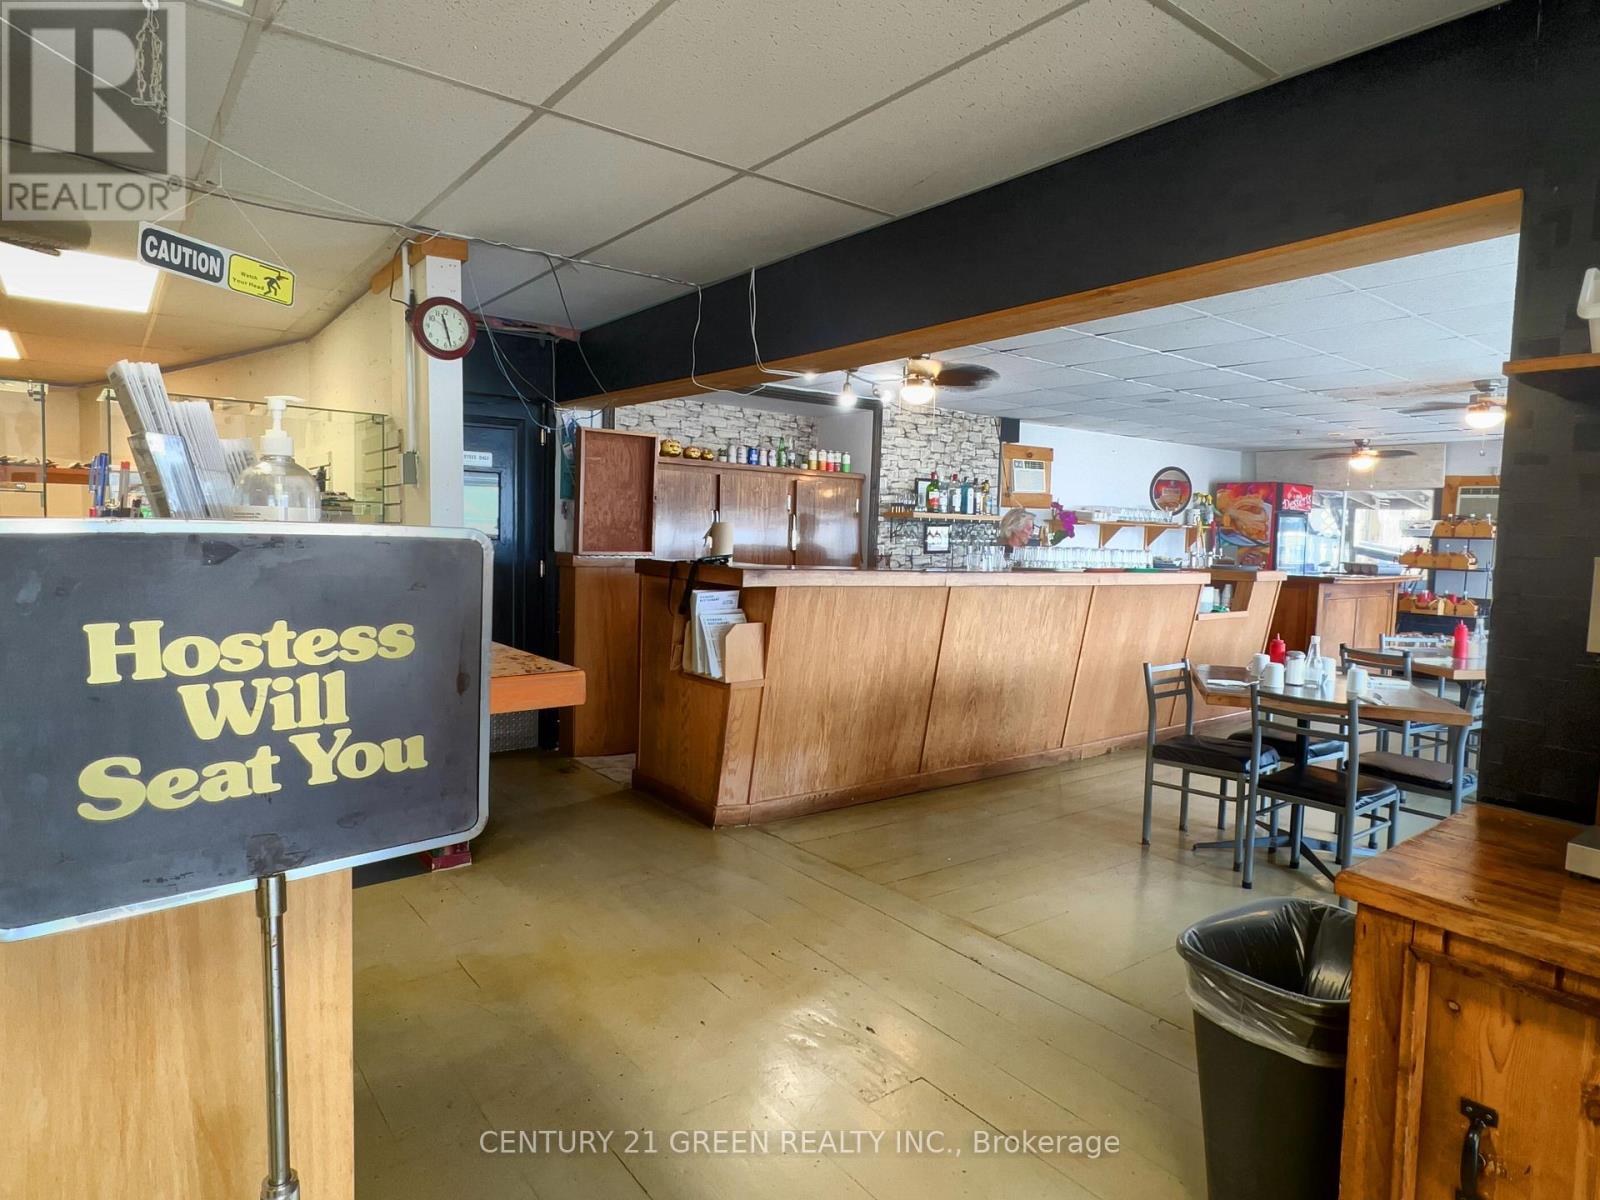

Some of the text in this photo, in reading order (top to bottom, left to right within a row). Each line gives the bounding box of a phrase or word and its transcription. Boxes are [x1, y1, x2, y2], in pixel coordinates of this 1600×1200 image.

[145, 235, 221, 278] CAUTION
[83, 619, 416, 684] Hostess
[177, 669, 350, 741] Will
[77, 728, 428, 821] Seat You
